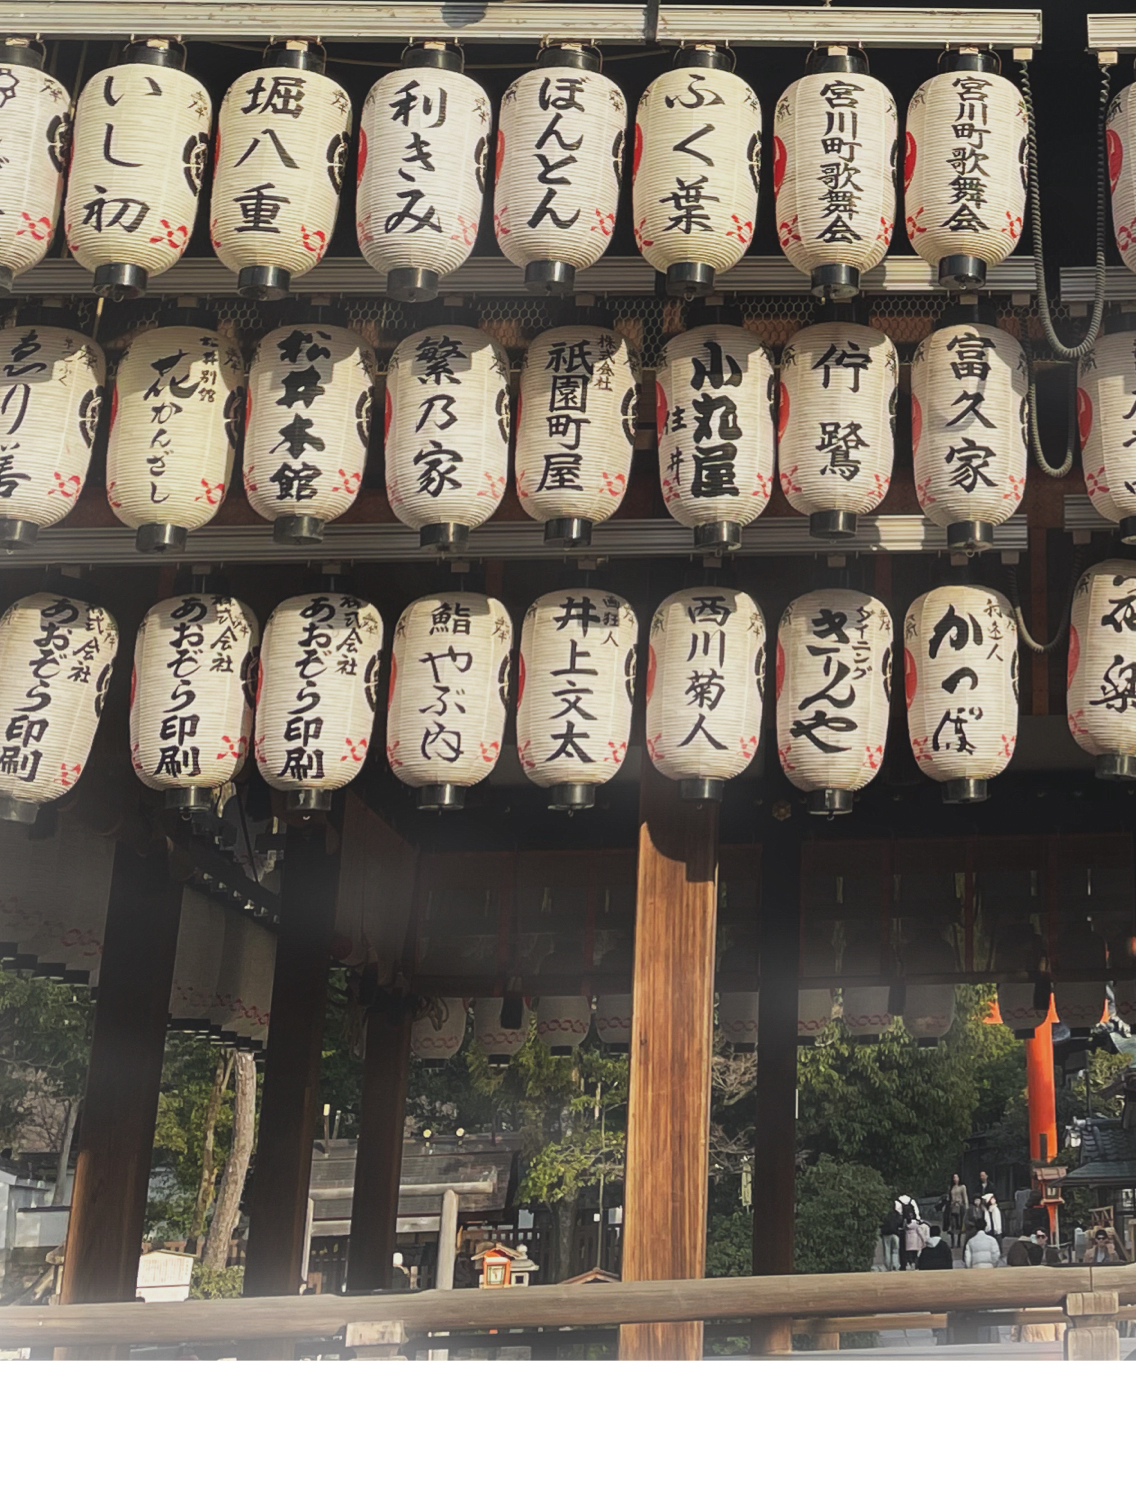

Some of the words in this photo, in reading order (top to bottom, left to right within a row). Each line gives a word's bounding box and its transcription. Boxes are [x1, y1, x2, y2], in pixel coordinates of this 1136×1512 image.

[83, 75, 162, 233] いし初
[234, 76, 307, 234] 堀八重
[385, 79, 447, 234] 利きみ
[659, 74, 726, 234] ふく葉
[817, 79, 864, 244] 宮川町歌舞会
[939, 76, 993, 233] 宮川町歌舞会
[269, 330, 332, 502] 松井本館
[413, 335, 467, 498] 繁乃家
[535, 340, 594, 493] 祇園町屋
[690, 341, 743, 498] 小丸屋
[945, 332, 999, 494] 富久家
[0, 598, 79, 782] あおぞら印刷
[152, 597, 209, 777] あおぞら印刷
[277, 597, 336, 780] あおぞら印刷
[545, 597, 600, 764] 井上文太
[677, 595, 731, 751] 西川菊人
[851, 605, 876, 680] ダイニング
